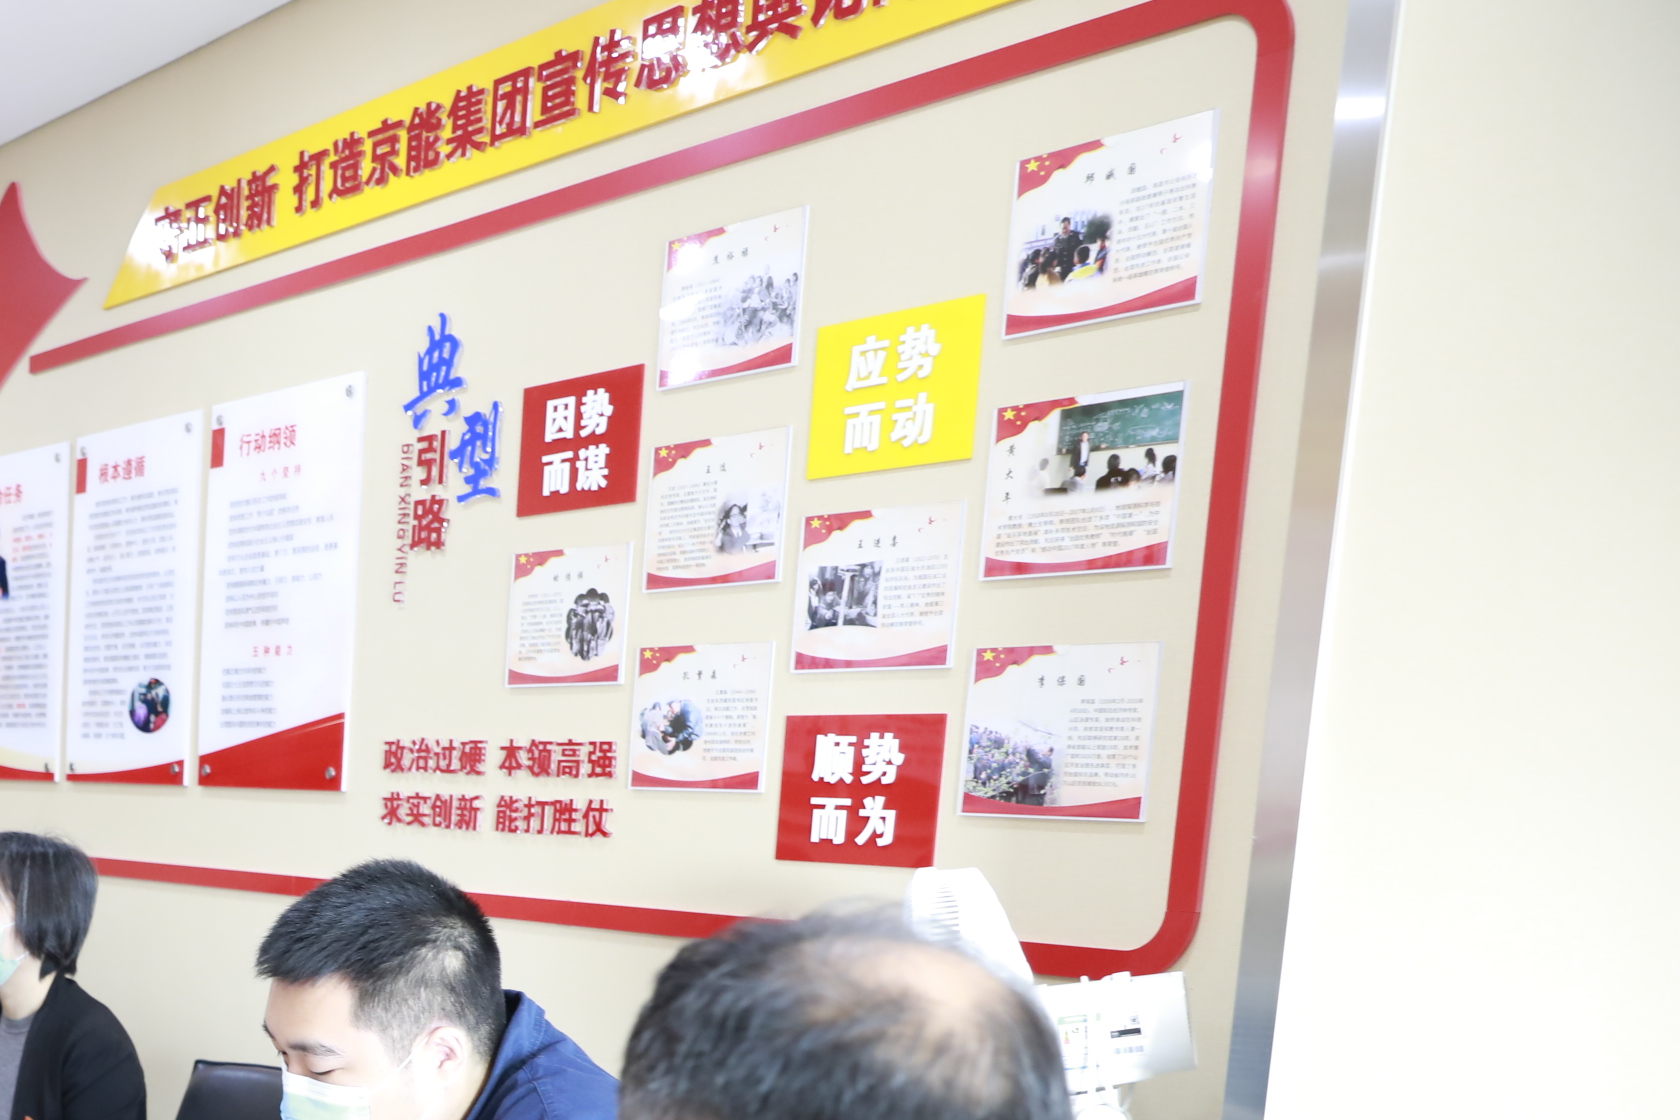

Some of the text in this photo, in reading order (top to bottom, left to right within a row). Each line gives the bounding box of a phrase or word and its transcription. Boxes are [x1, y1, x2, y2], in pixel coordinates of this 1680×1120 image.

[292, 0, 888, 217] 打造京能集团宣传思想典
[844, 323, 942, 393] 应势
[239, 424, 297, 458] 行动纲领
[543, 388, 613, 443] 因势
[843, 392, 935, 455] 而动
[98, 455, 146, 484] 根本遵循
[409, 429, 450, 552] 引路
[541, 443, 610, 497] 而谋
[382, 737, 617, 779] 政治过硬 本领高强
[810, 732, 906, 785] 顺势
[380, 791, 613, 838] 求实创新 能打胜仗
[809, 795, 897, 847] 而为
